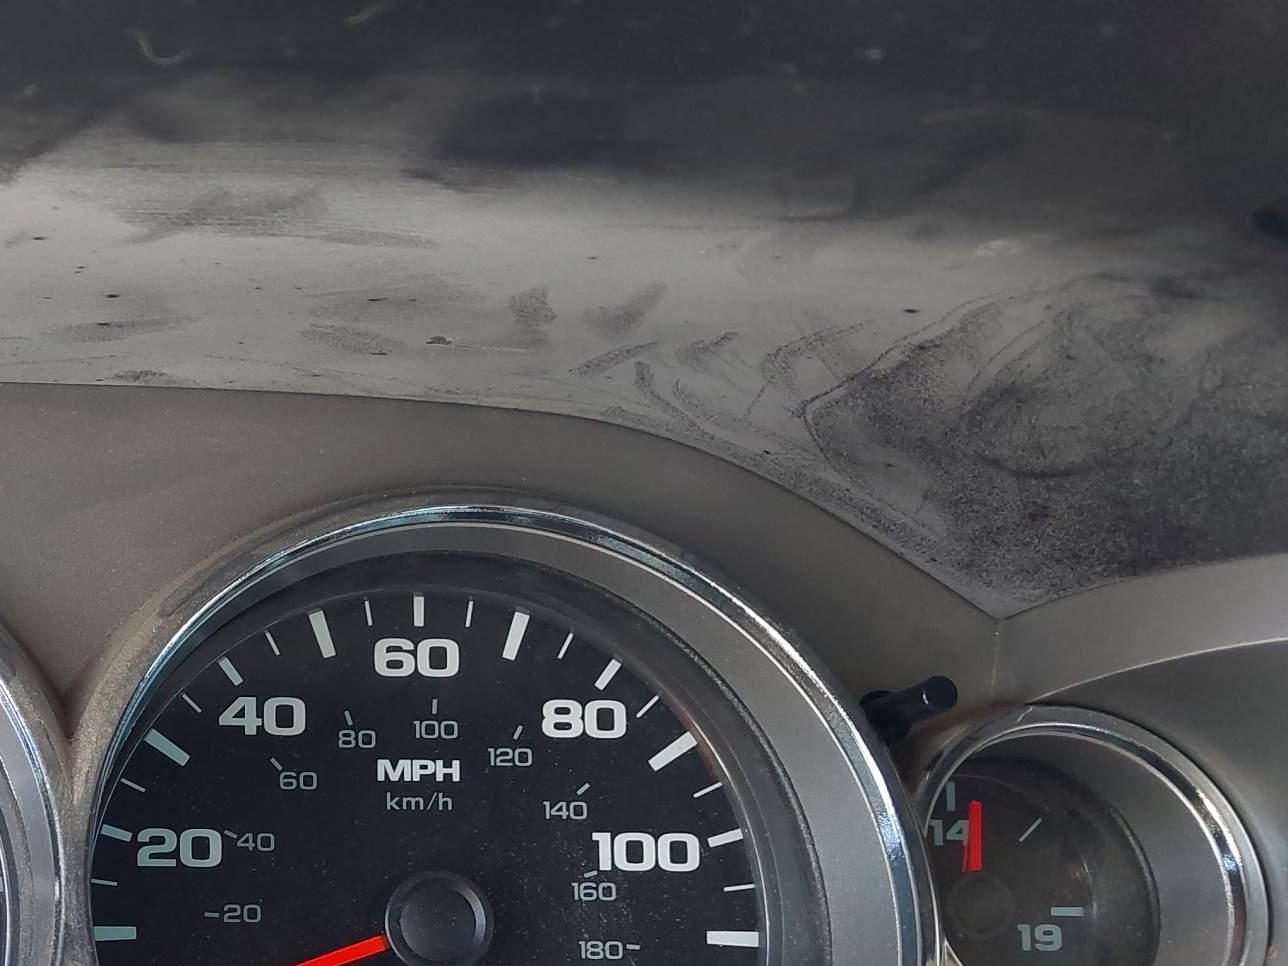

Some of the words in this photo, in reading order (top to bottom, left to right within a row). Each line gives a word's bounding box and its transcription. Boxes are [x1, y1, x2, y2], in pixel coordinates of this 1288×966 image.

[373, 638, 460, 677] 60
[218, 696, 306, 736] 40
[541, 699, 626, 739] 80
[337, 729, 377, 749] 80
[413, 720, 458, 740] 100
[488, 747, 533, 767] 120
[376, 758, 460, 782] MPH
[278, 771, 318, 791] 60
[386, 791, 453, 811] km/h
[544, 801, 588, 820] 140
[234, 832, 276, 852] 40
[929, 819, 969, 846] 14
[136, 828, 223, 868] 20
[592, 832, 700, 872] 100
[572, 883, 617, 902] 160
[222, 904, 262, 924] 20
[1017, 924, 1063, 951] 19
[579, 941, 624, 960] 180
